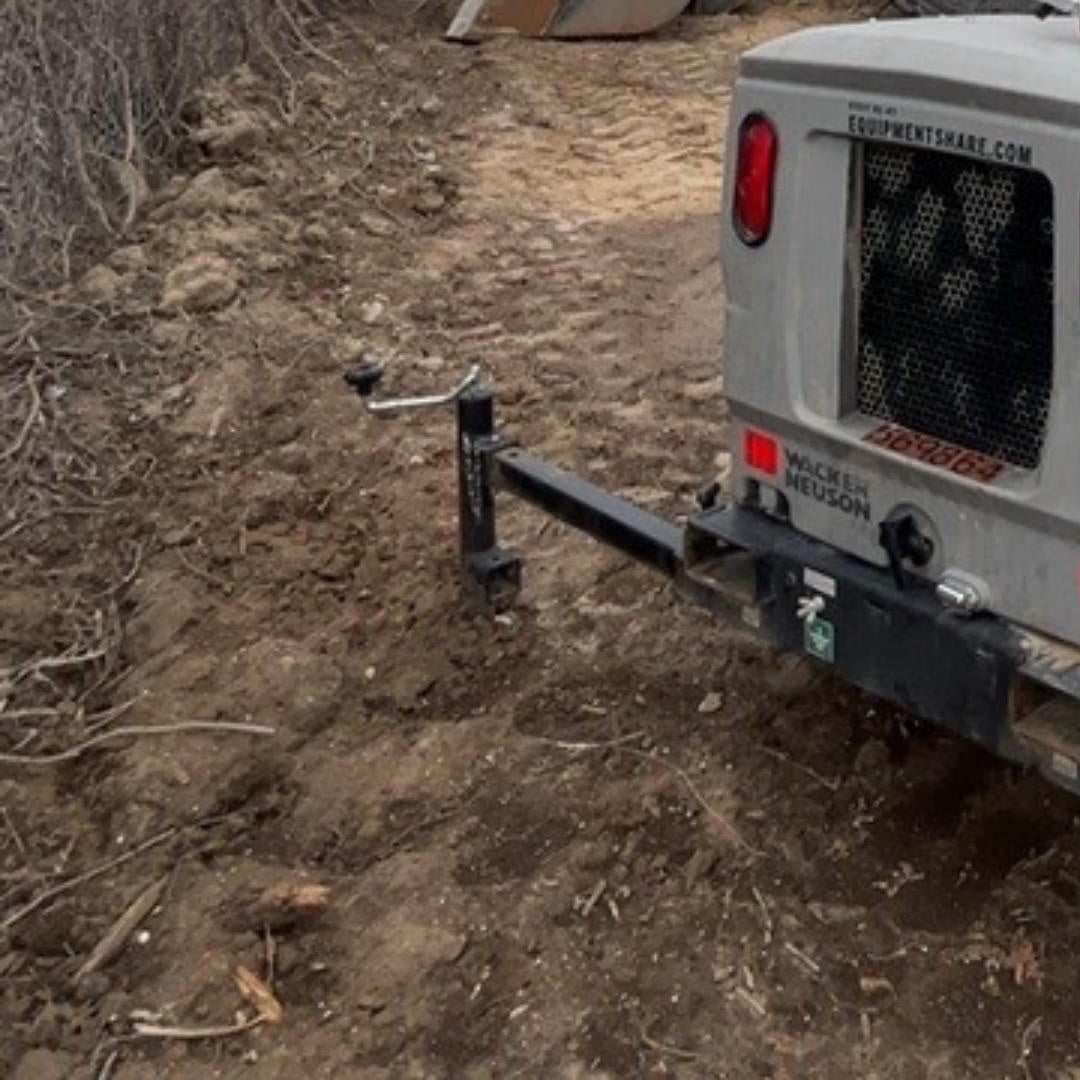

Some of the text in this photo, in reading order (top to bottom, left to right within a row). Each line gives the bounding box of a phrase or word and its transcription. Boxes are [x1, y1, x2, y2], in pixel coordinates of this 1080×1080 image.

[848, 114, 1033, 165] EQUIPMENTSHARE.COM
[785, 449, 868, 500] WACKER
[785, 469, 871, 522] NEUSON
